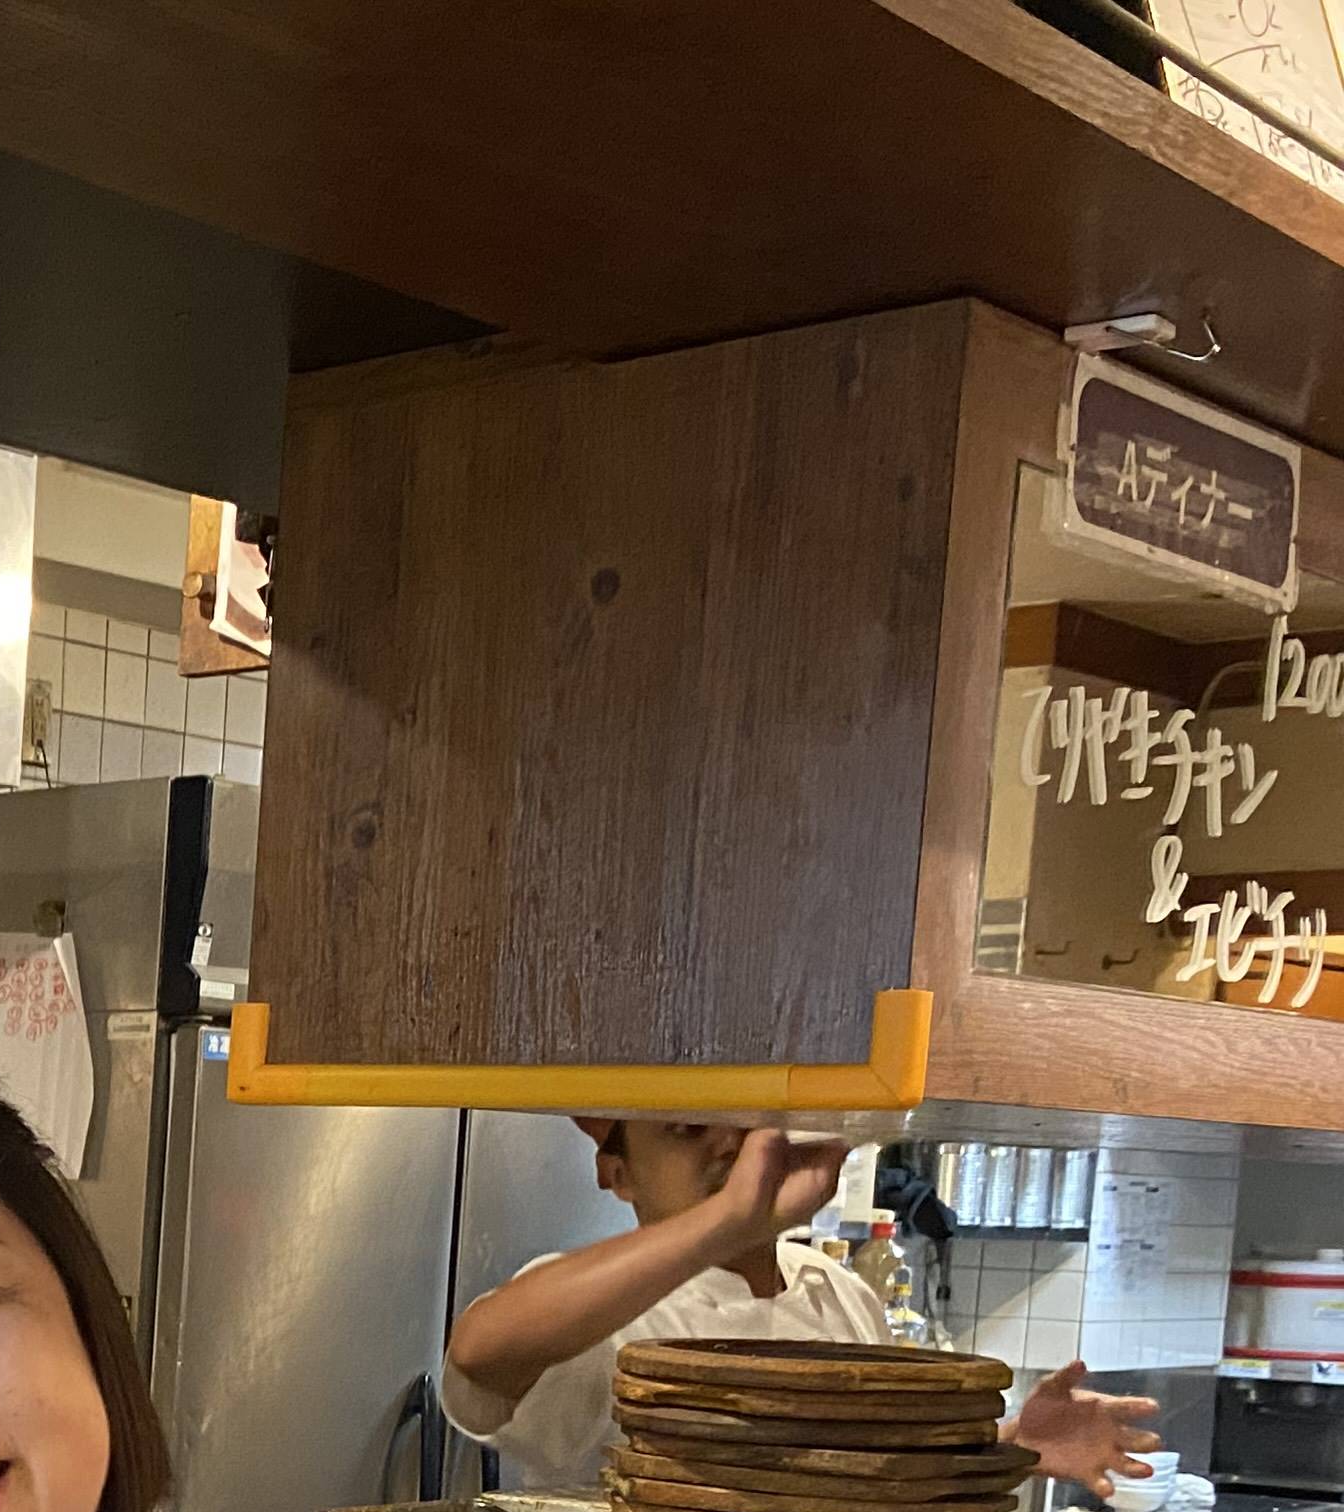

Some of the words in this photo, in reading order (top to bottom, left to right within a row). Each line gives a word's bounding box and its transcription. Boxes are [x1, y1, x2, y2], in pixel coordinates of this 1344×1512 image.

[1117, 440, 1253, 529] Aディナー
[1021, 685, 1278, 838] てりやきチキン
[1146, 835, 1189, 924] &
